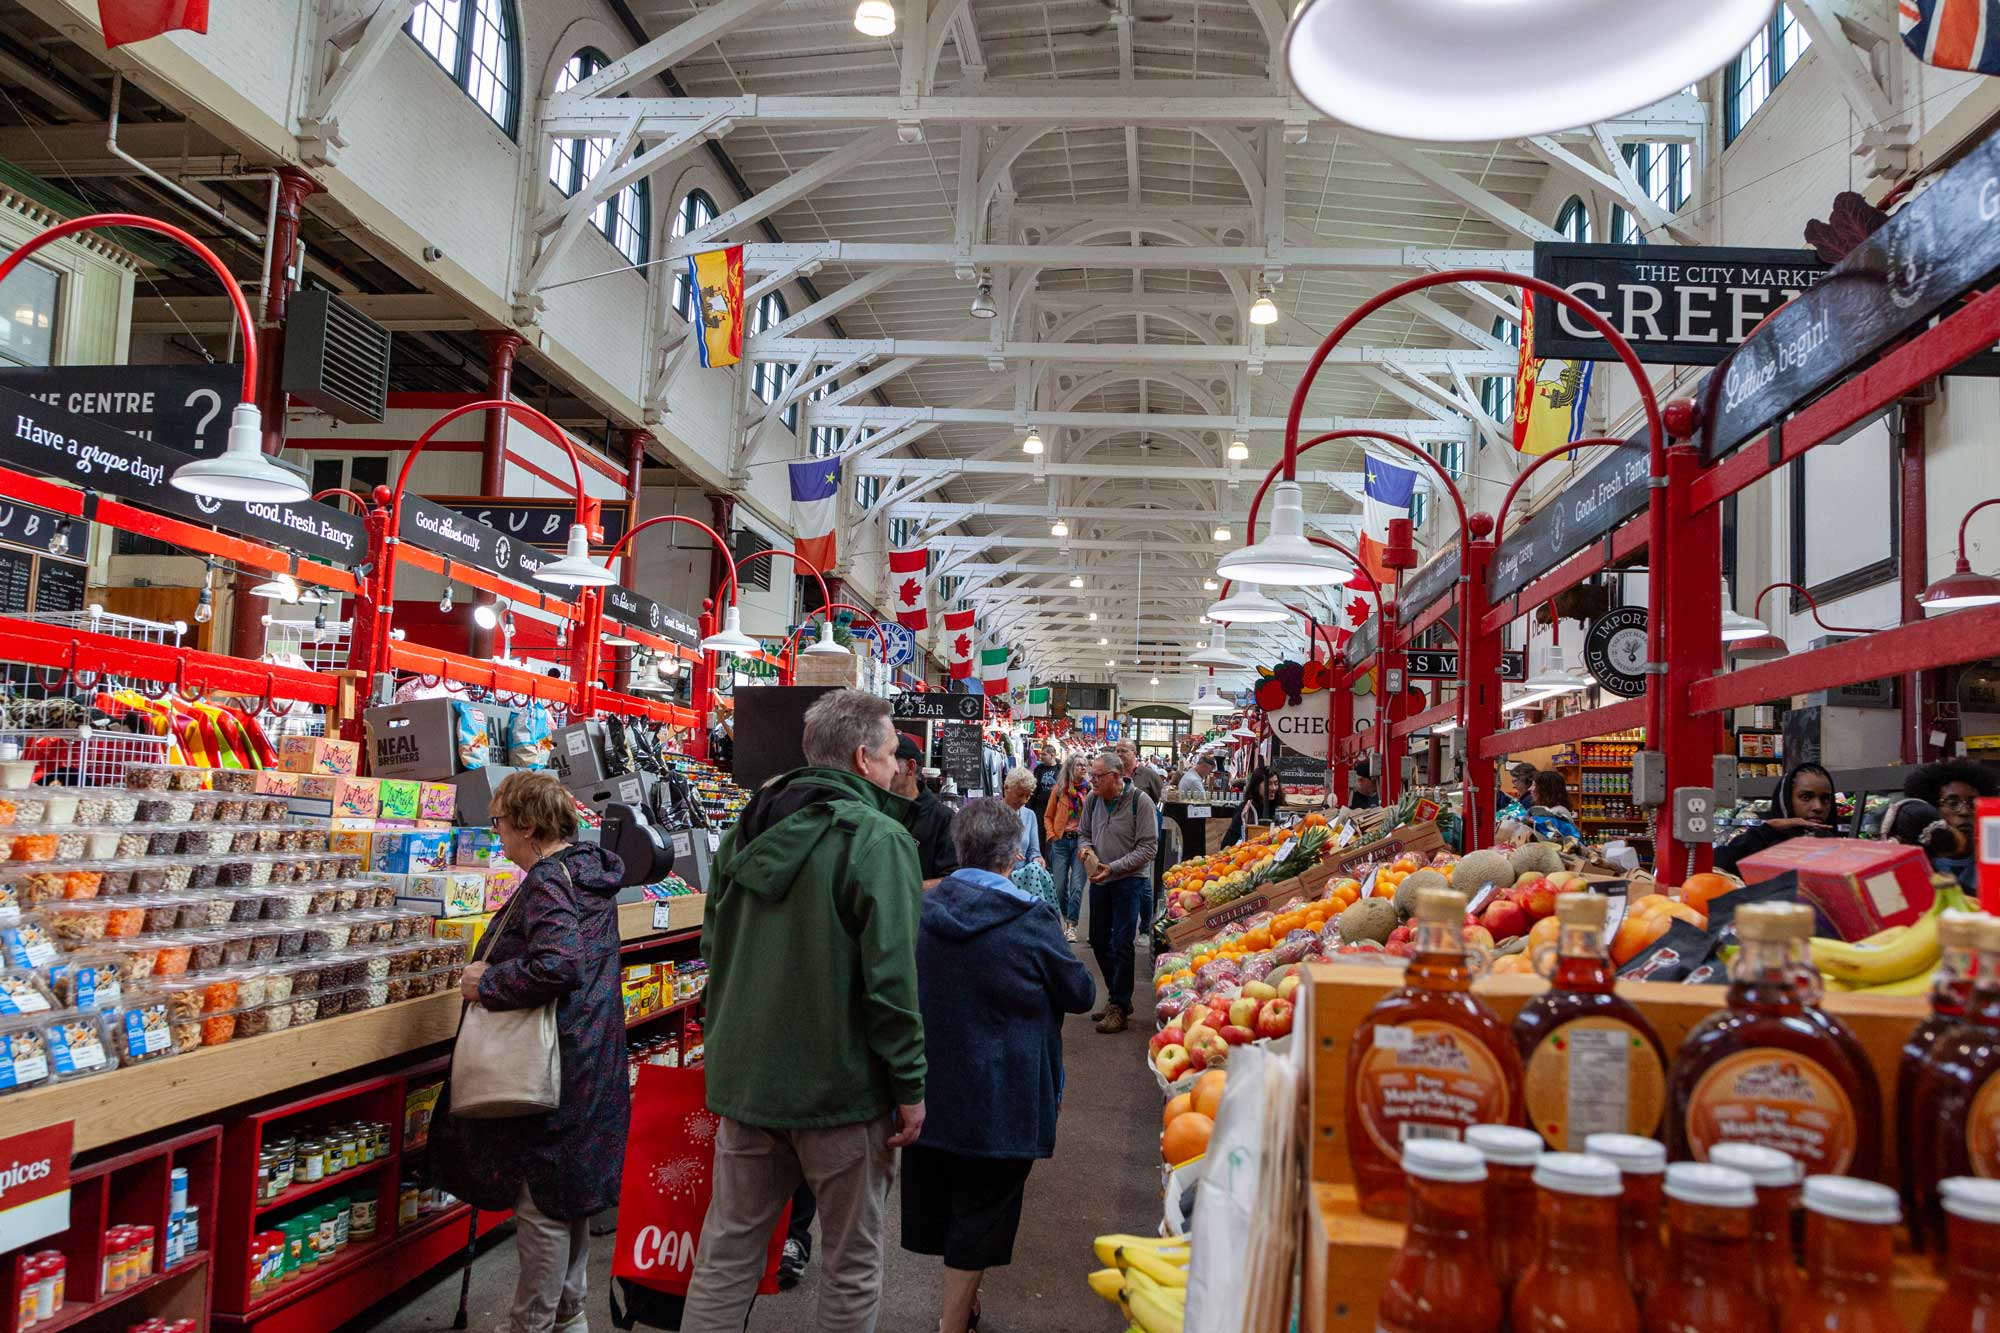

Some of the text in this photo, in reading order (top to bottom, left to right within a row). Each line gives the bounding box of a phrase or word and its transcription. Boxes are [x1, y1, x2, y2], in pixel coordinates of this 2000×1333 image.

[1636, 265, 1680, 282] THE
[1686, 267, 1735, 284] CITY
[1557, 282, 1803, 343] GREE
[1778, 308, 1830, 374] begin!
[68, 392, 155, 414] CENTRE
[16, 415, 165, 487] Have a grape day!
[1575, 490, 1597, 522] Good.
[1599, 472, 1624, 505] Fresh.
[245, 501, 281, 524] Good.
[283, 508, 319, 536] Fresh.
[320, 521, 354, 551] Fancy.
[416, 511, 439, 533] Good
[462, 533, 481, 552] only.
[1596, 613, 1649, 639] IMPORT
[918, 703, 944, 715] BAR
[377, 734, 419, 757] NEAL
[377, 750, 420, 767] BROTHERS
[0, 1157, 51, 1197] pices
[633, 1224, 697, 1273] CAN
